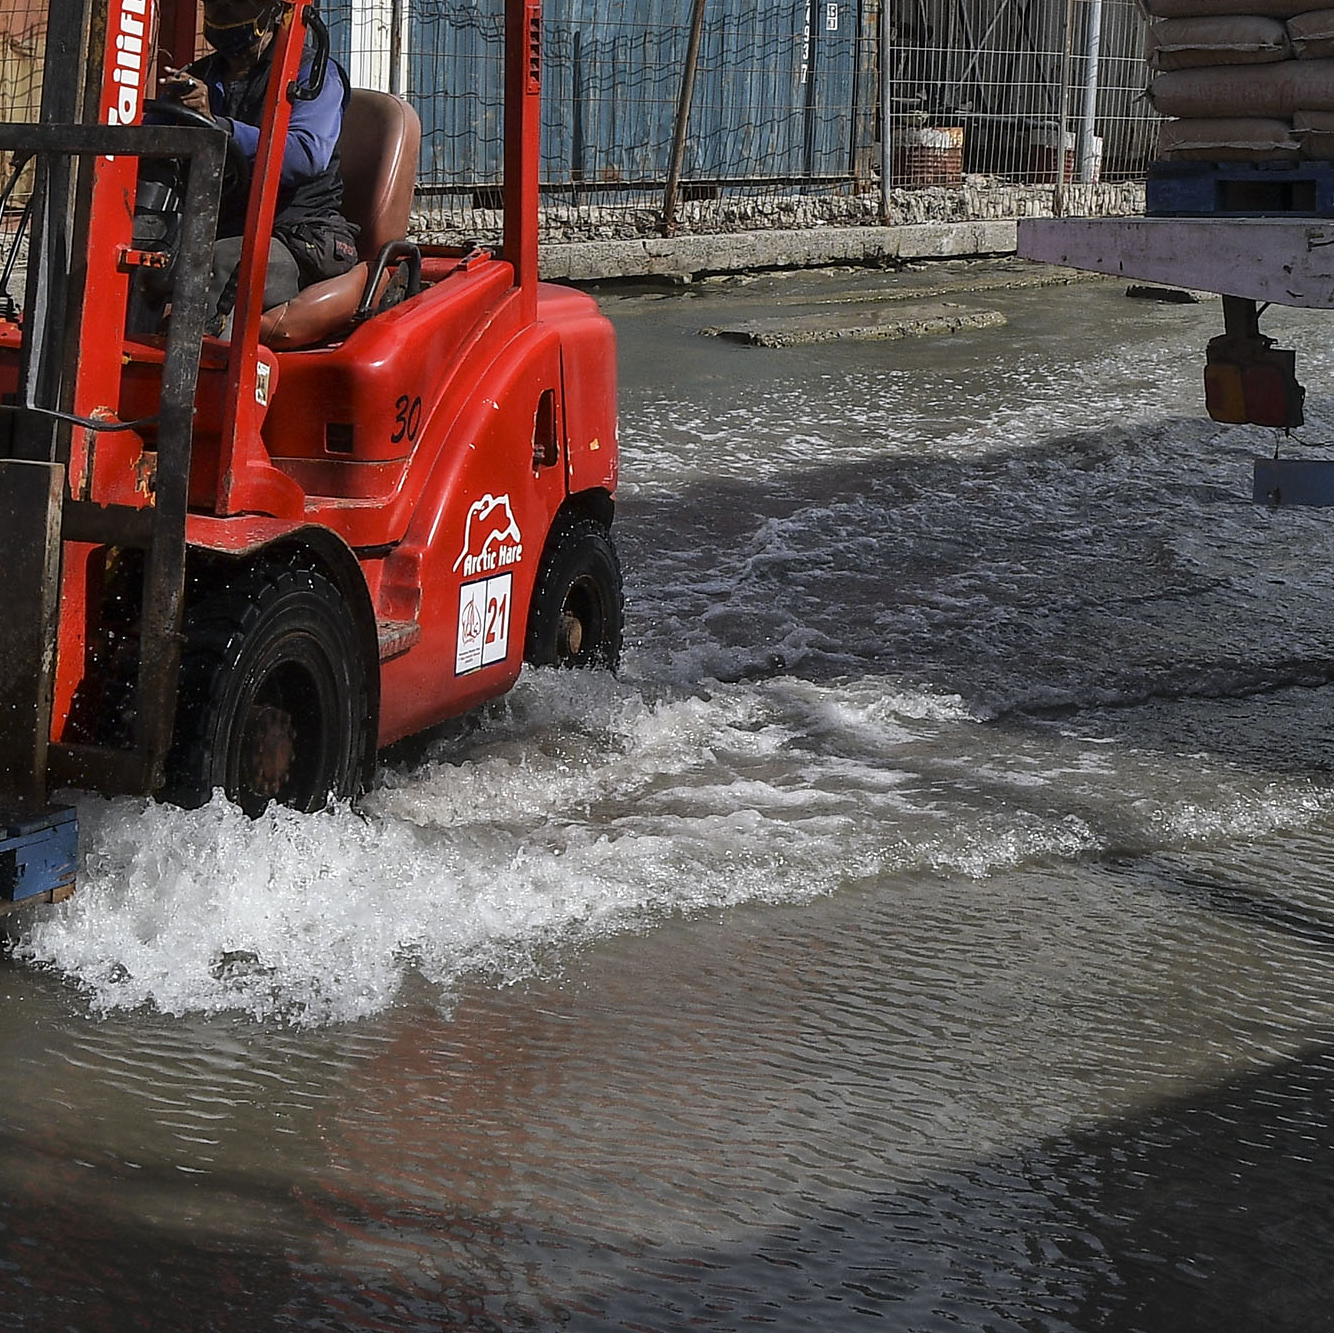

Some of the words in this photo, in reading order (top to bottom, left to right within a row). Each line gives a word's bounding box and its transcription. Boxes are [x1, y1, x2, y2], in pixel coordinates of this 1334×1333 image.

[390, 394, 421, 444] 30
[498, 544, 523, 567] Hare
[484, 592, 508, 645] 21
